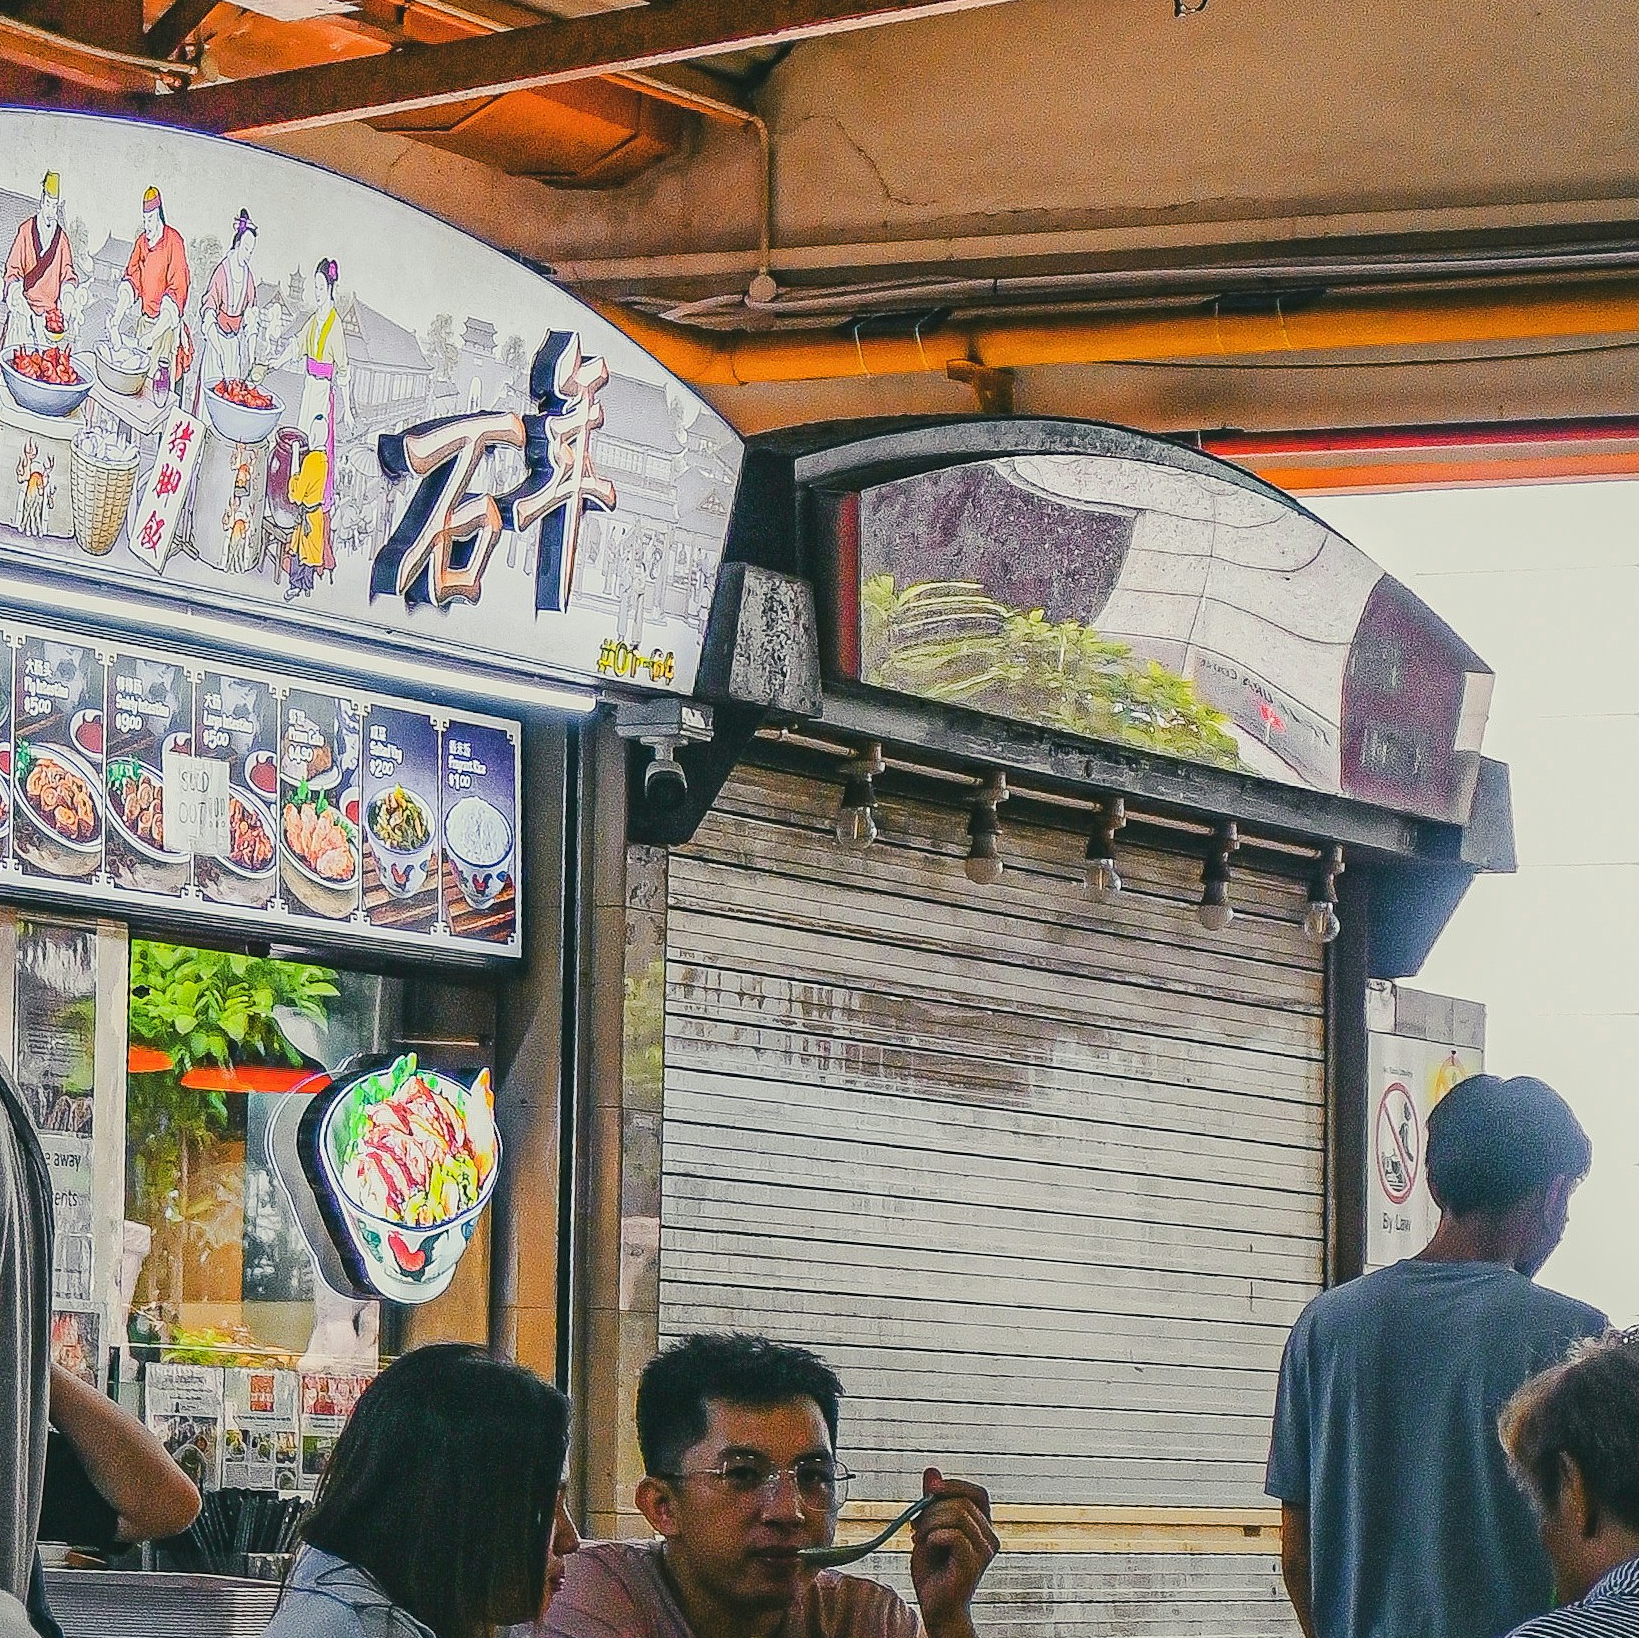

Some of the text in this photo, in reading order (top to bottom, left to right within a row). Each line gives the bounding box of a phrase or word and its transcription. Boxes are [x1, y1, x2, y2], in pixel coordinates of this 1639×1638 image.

[54, 1154, 82, 1172] away
[54, 1189, 78, 1208] ents
[1382, 1212, 1395, 1234] By
